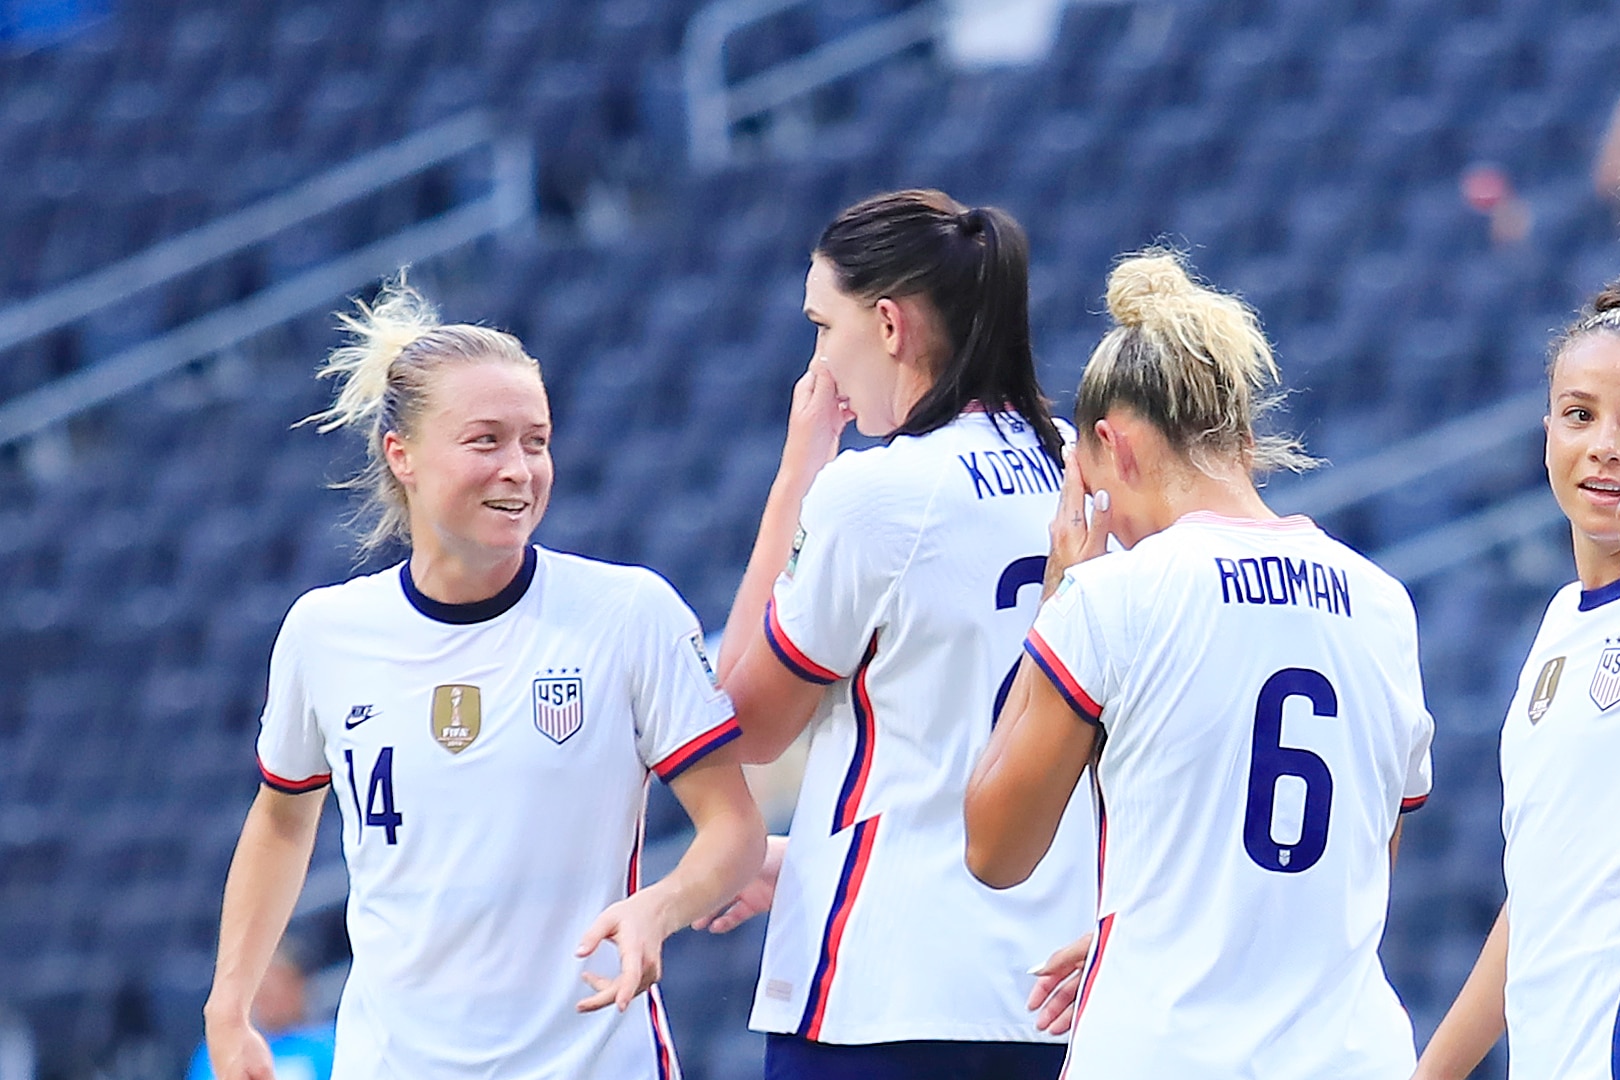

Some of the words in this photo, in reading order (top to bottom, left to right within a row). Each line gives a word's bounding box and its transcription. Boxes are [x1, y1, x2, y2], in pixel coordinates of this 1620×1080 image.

[957, 446, 1061, 500] KORNI
[1213, 556, 1353, 619] RODMAN
[538, 683, 577, 706] USA
[344, 746, 403, 846] 14
[1243, 667, 1338, 873] 6
